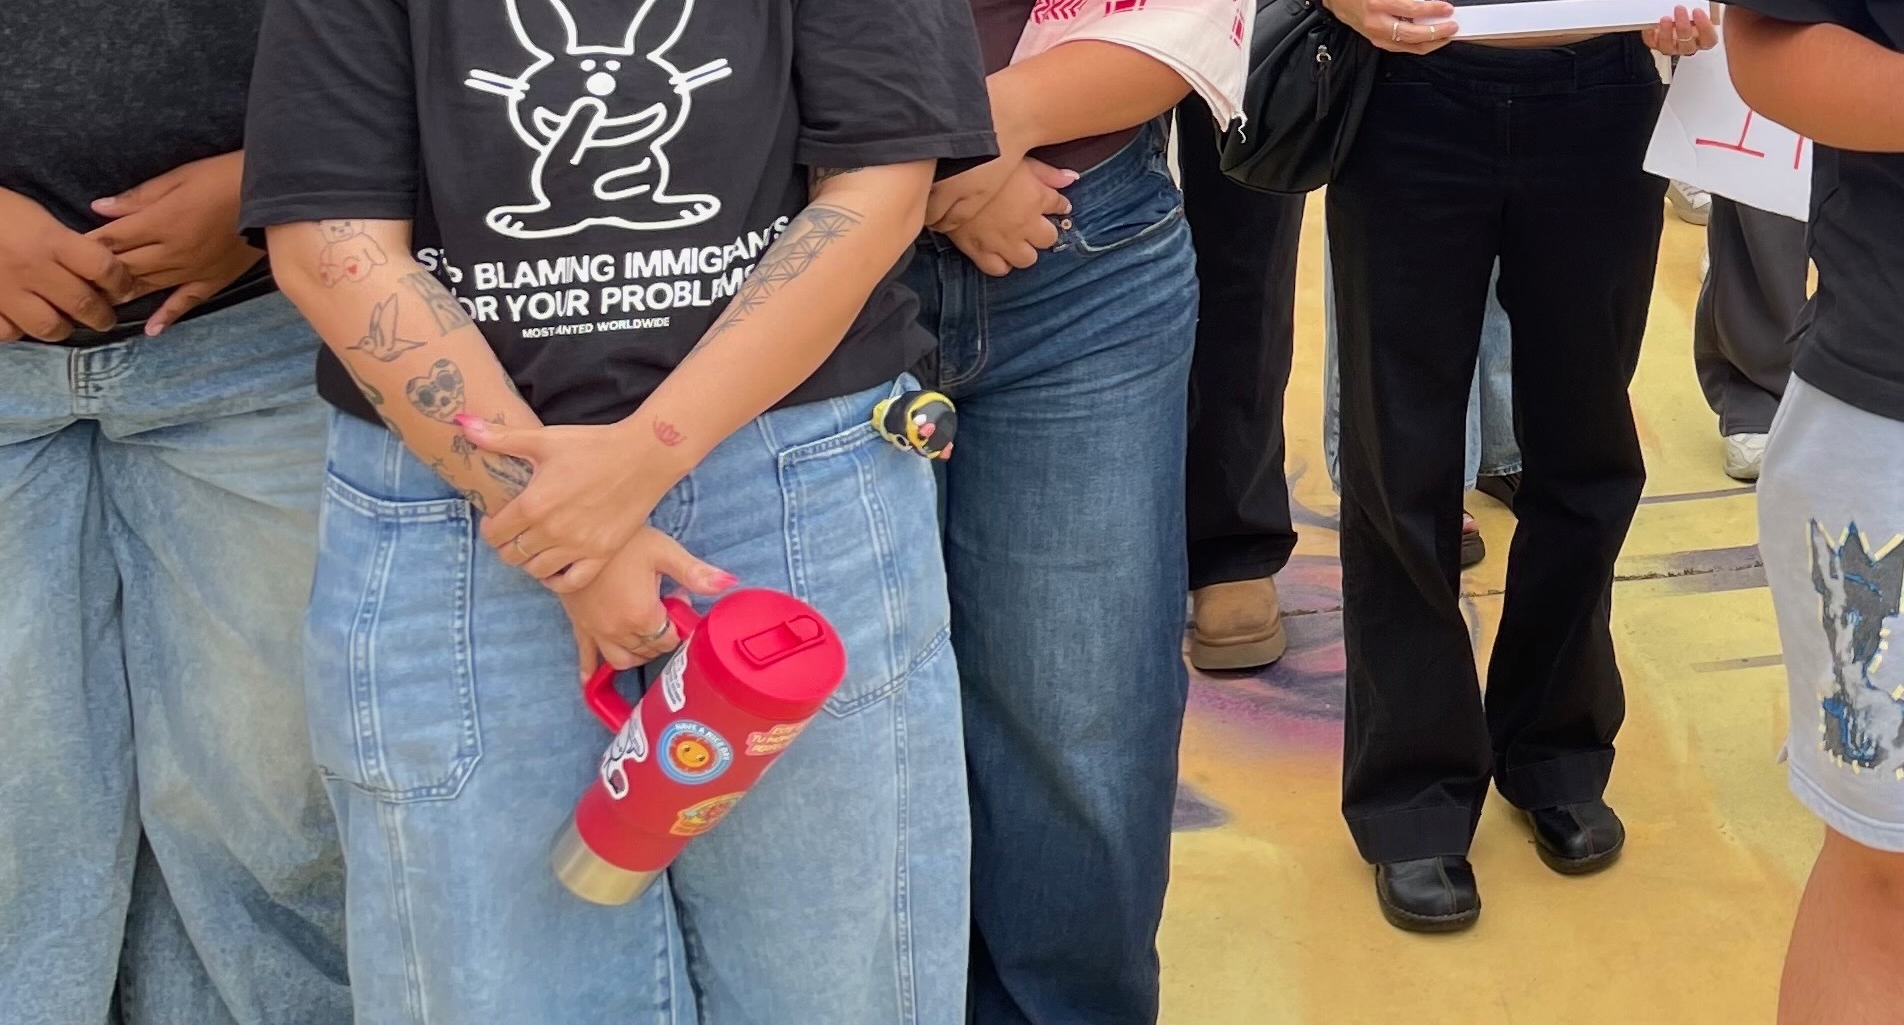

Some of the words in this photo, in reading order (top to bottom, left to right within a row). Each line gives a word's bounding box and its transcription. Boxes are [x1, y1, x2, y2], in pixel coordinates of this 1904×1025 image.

[474, 253, 615, 291] BLAMING
[451, 287, 499, 322] OR
[506, 288, 590, 322] YOUR
[597, 316, 670, 332] WORLDWIDE
